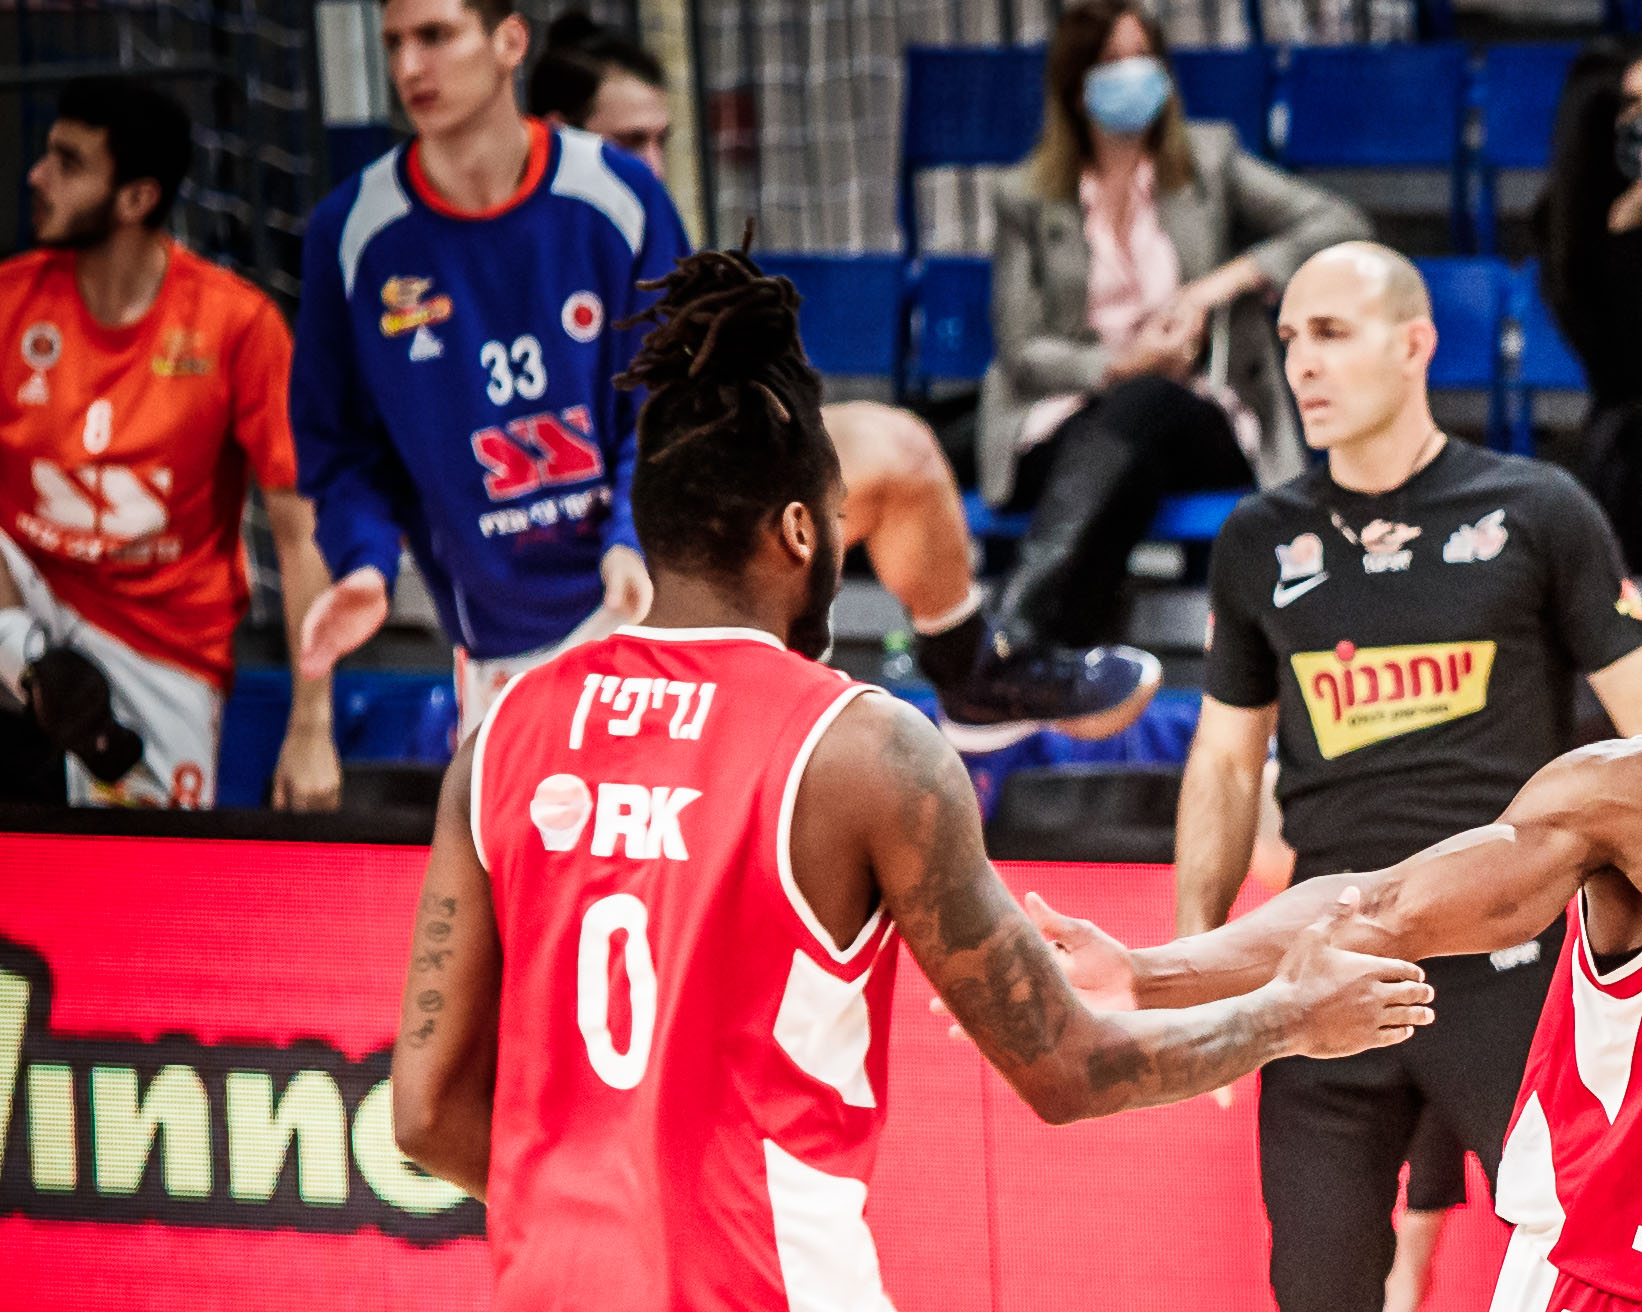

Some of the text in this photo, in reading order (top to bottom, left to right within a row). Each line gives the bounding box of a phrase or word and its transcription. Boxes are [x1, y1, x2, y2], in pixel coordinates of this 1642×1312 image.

[479, 333, 548, 406] 33
[569, 673, 717, 750] גריפין
[1313, 650, 1473, 725] יוחננוף
[590, 782, 703, 861] RK
[577, 893, 658, 1090] 0
[0, 968, 472, 1216] inne
